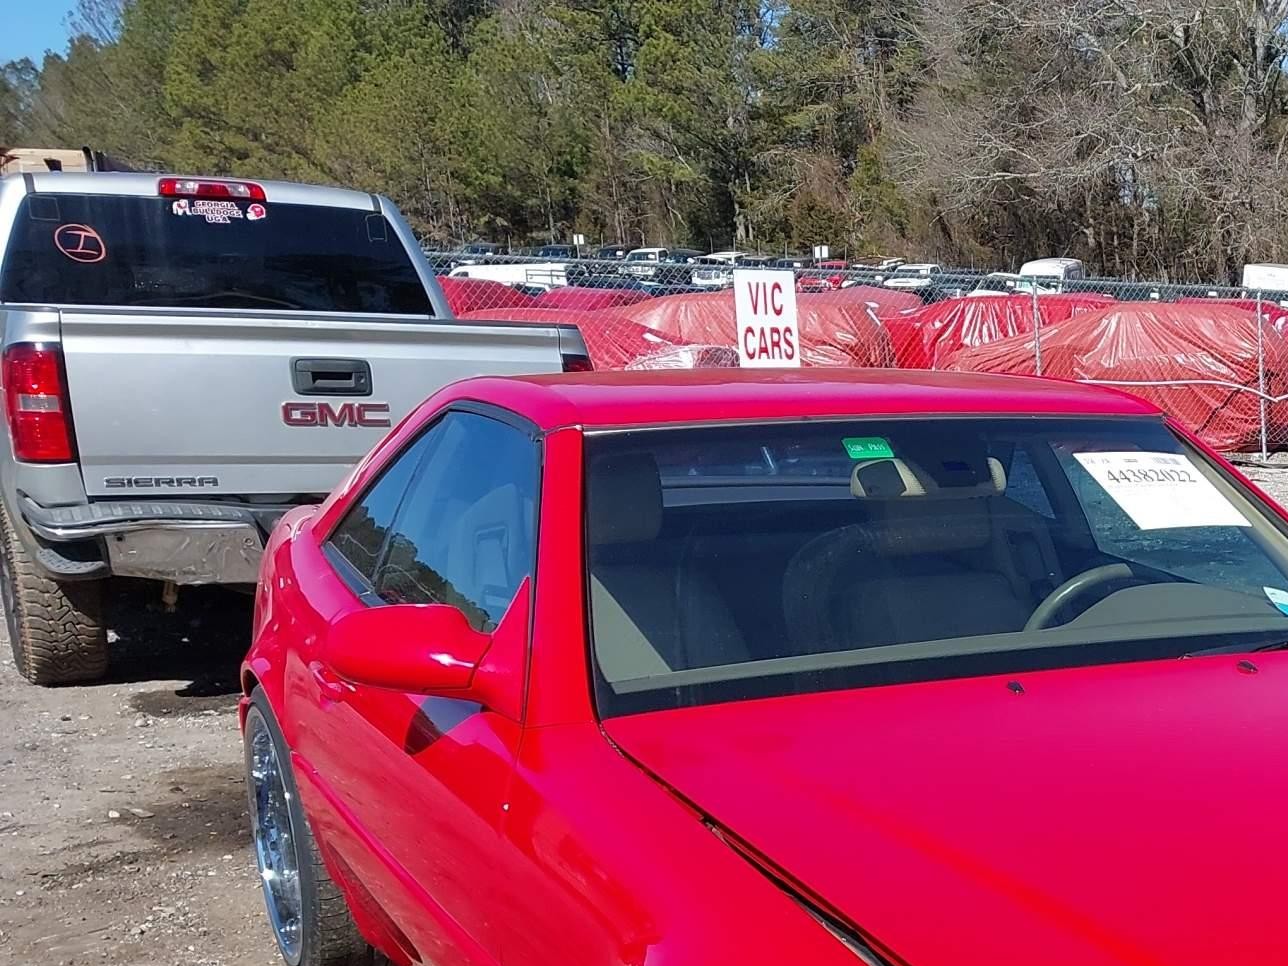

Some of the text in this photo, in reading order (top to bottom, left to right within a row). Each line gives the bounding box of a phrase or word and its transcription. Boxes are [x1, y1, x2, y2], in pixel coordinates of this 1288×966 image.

[194, 200, 238, 210] GEORGIA
[191, 207, 243, 217] BULLDOGS
[205, 215, 230, 223] UGA
[747, 281, 784, 316] VIC
[743, 326, 795, 360] CARS
[281, 401, 391, 428] GMC
[103, 476, 219, 488] SIERRA
